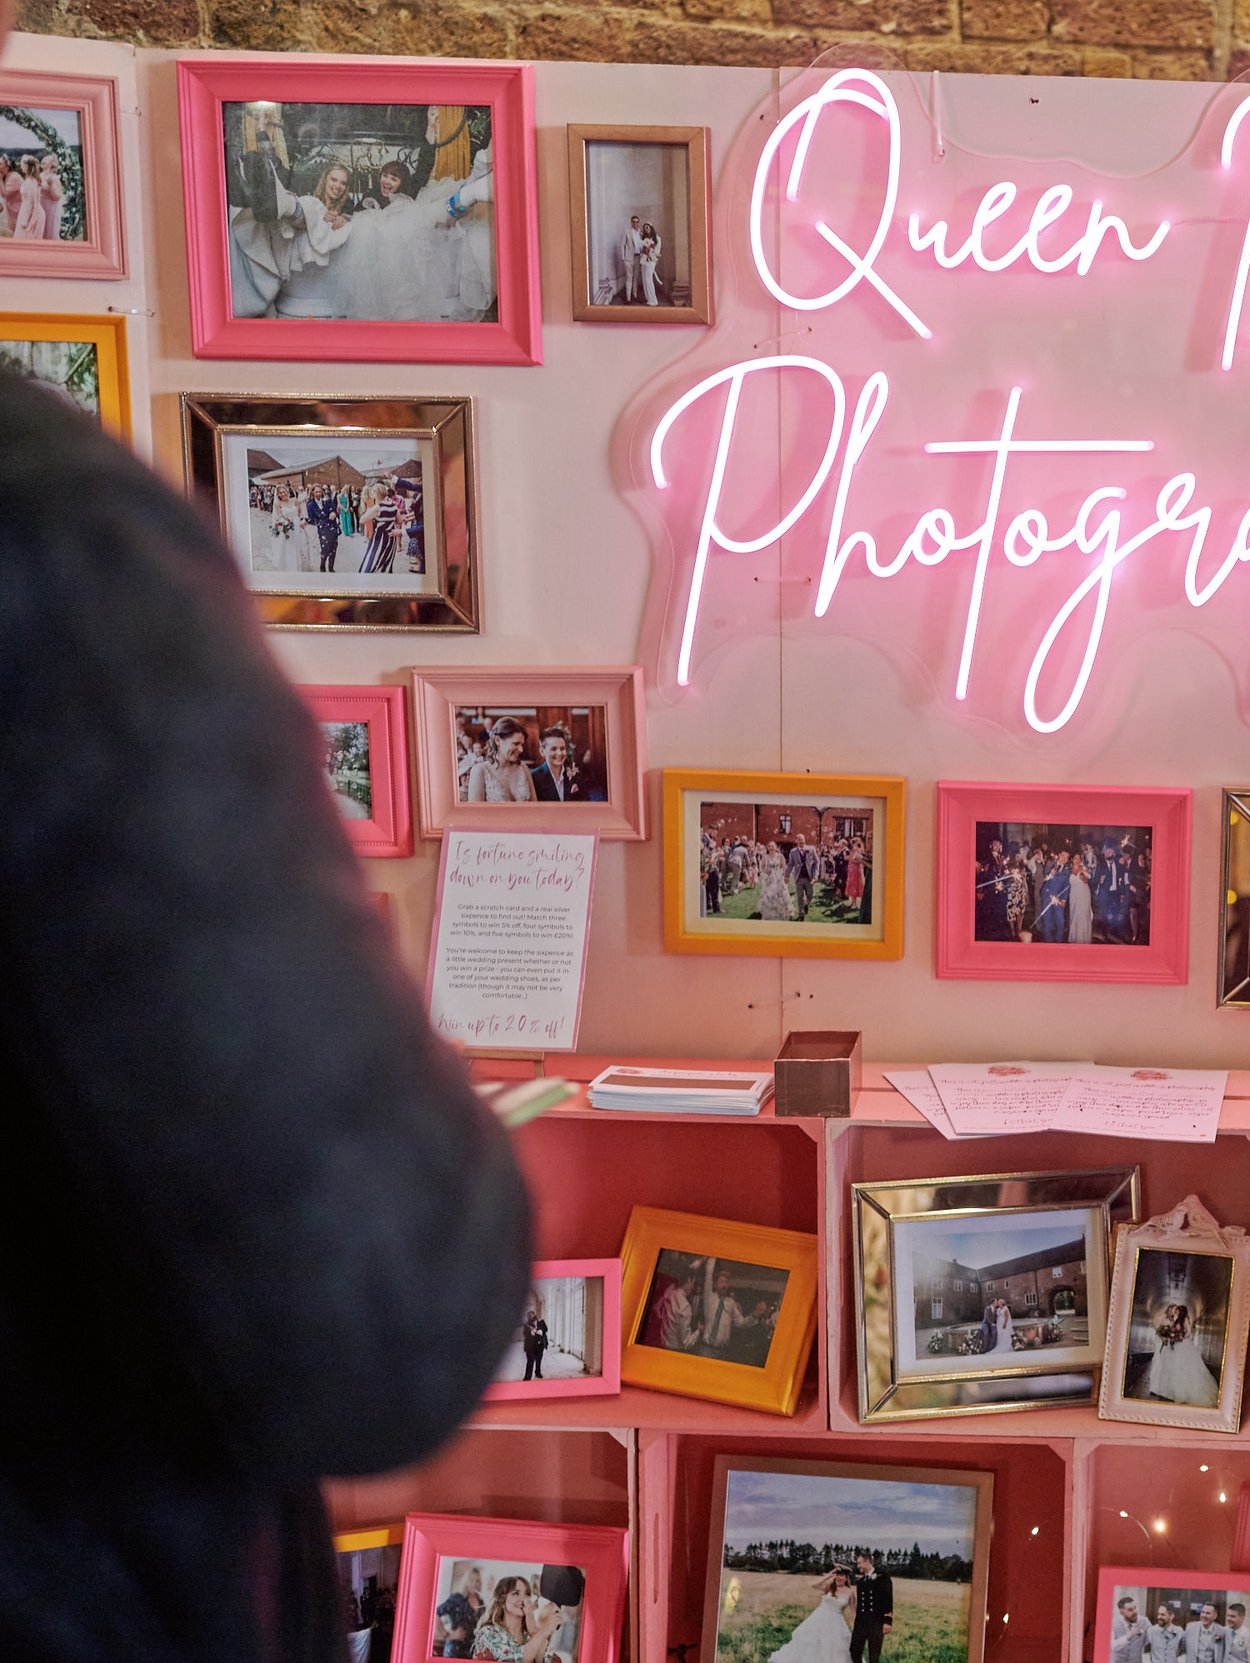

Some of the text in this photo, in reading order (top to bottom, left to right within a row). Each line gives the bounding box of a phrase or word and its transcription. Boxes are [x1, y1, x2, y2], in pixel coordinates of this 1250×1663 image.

[749, 66, 1172, 340] Queen
[456, 840, 585, 868] Is fortune smiling
[449, 865, 585, 892] down on you today?
[457, 903, 474, 911] Grab
[480, 904, 504, 912] scratch
[460, 913, 489, 921] sixpence
[452, 921, 479, 929] symbols
[537, 923, 565, 931] symbols
[504, 931, 531, 939] symbols
[467, 956, 496, 964] wedding
[497, 957, 522, 965] present
[500, 966, 512, 974] you
[489, 974, 519, 982] wedding
[448, 982, 477, 990] tradition
[477, 983, 505, 991] (though
[511, 984, 526, 992] may
[549, 985, 564, 993] very
[438, 1012, 464, 1032] Win
[467, 1019, 485, 1038] up
[486, 1014, 502, 1037] to
[544, 1015, 565, 1039] off!
